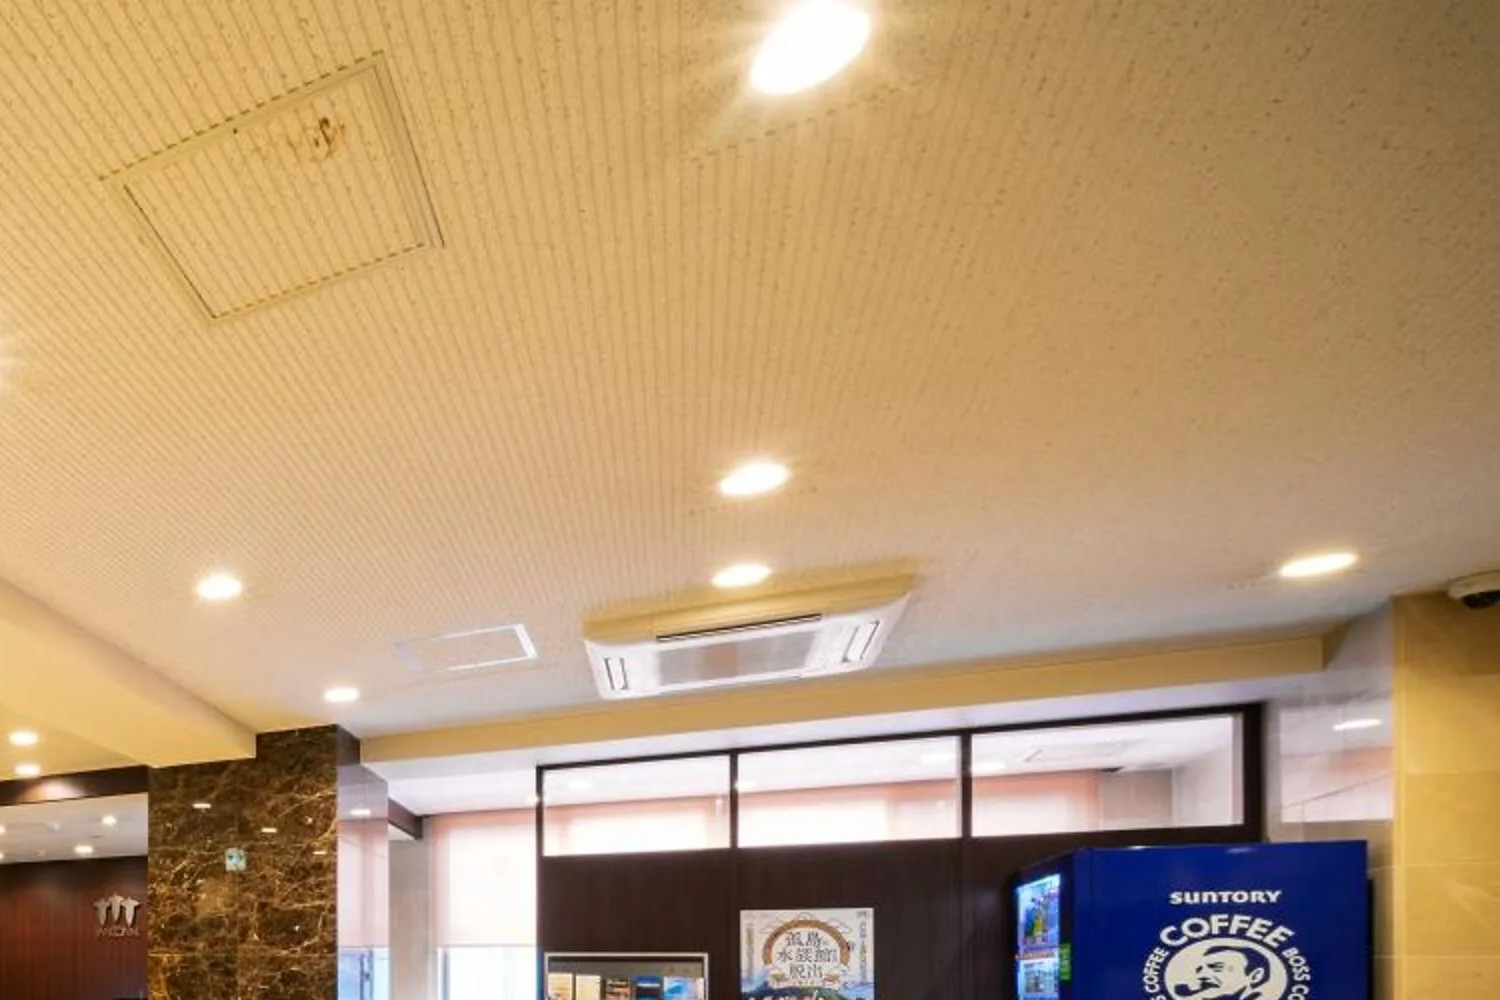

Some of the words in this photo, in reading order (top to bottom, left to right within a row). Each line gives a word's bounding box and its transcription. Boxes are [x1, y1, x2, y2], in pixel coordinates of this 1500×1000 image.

[1169, 889, 1282, 905] SUNTORY
[1159, 914, 1295, 948] COFFEE
[1142, 947, 1170, 993] COFFEE
[1281, 947, 1311, 983] BOSS
